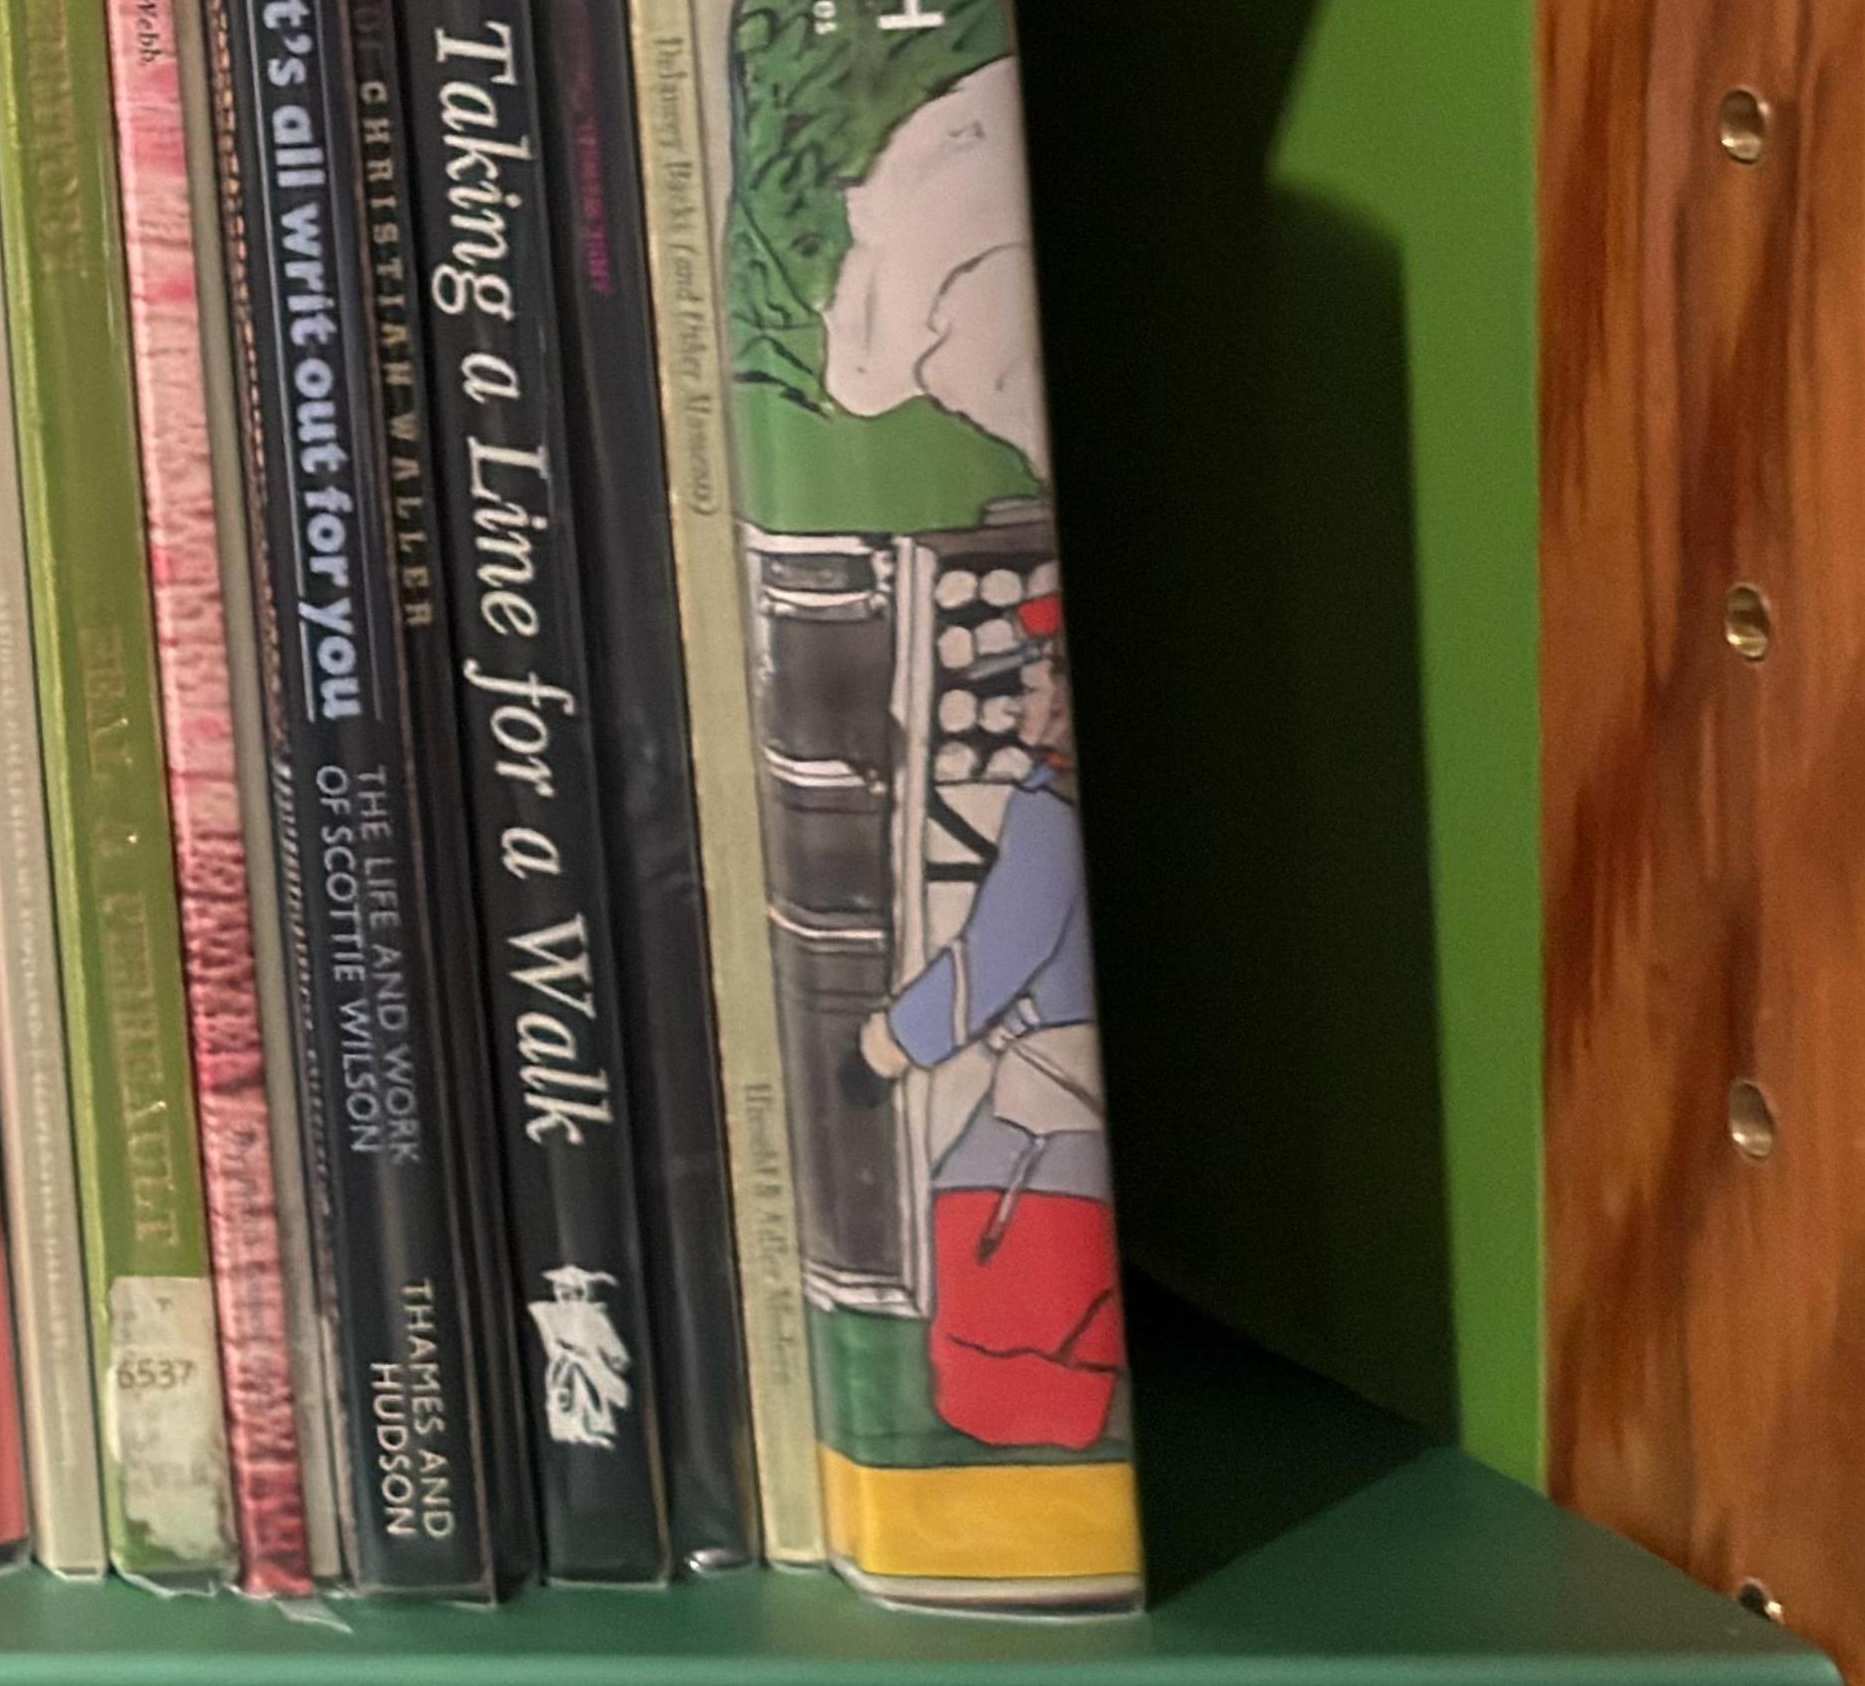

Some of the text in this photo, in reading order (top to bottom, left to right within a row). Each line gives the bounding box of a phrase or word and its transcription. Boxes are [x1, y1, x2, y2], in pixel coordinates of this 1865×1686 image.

[270, 103, 328, 188] all
[275, 201, 340, 344] writ
[357, 79, 417, 389] CHRISTIAN
[389, 411, 435, 630] WALLER
[288, 355, 345, 475] out
[301, 485, 356, 587] for
[429, 20, 616, 1146] Taking a Line for a Walk
[298, 598, 366, 723] you
[313, 764, 379, 1155] OF SCOTTIE WILSON
[356, 764, 422, 1166] THE LIFE AND WORK
[368, 1362, 416, 1538] HUDSON
[399, 1276, 457, 1539] THAMES AND
